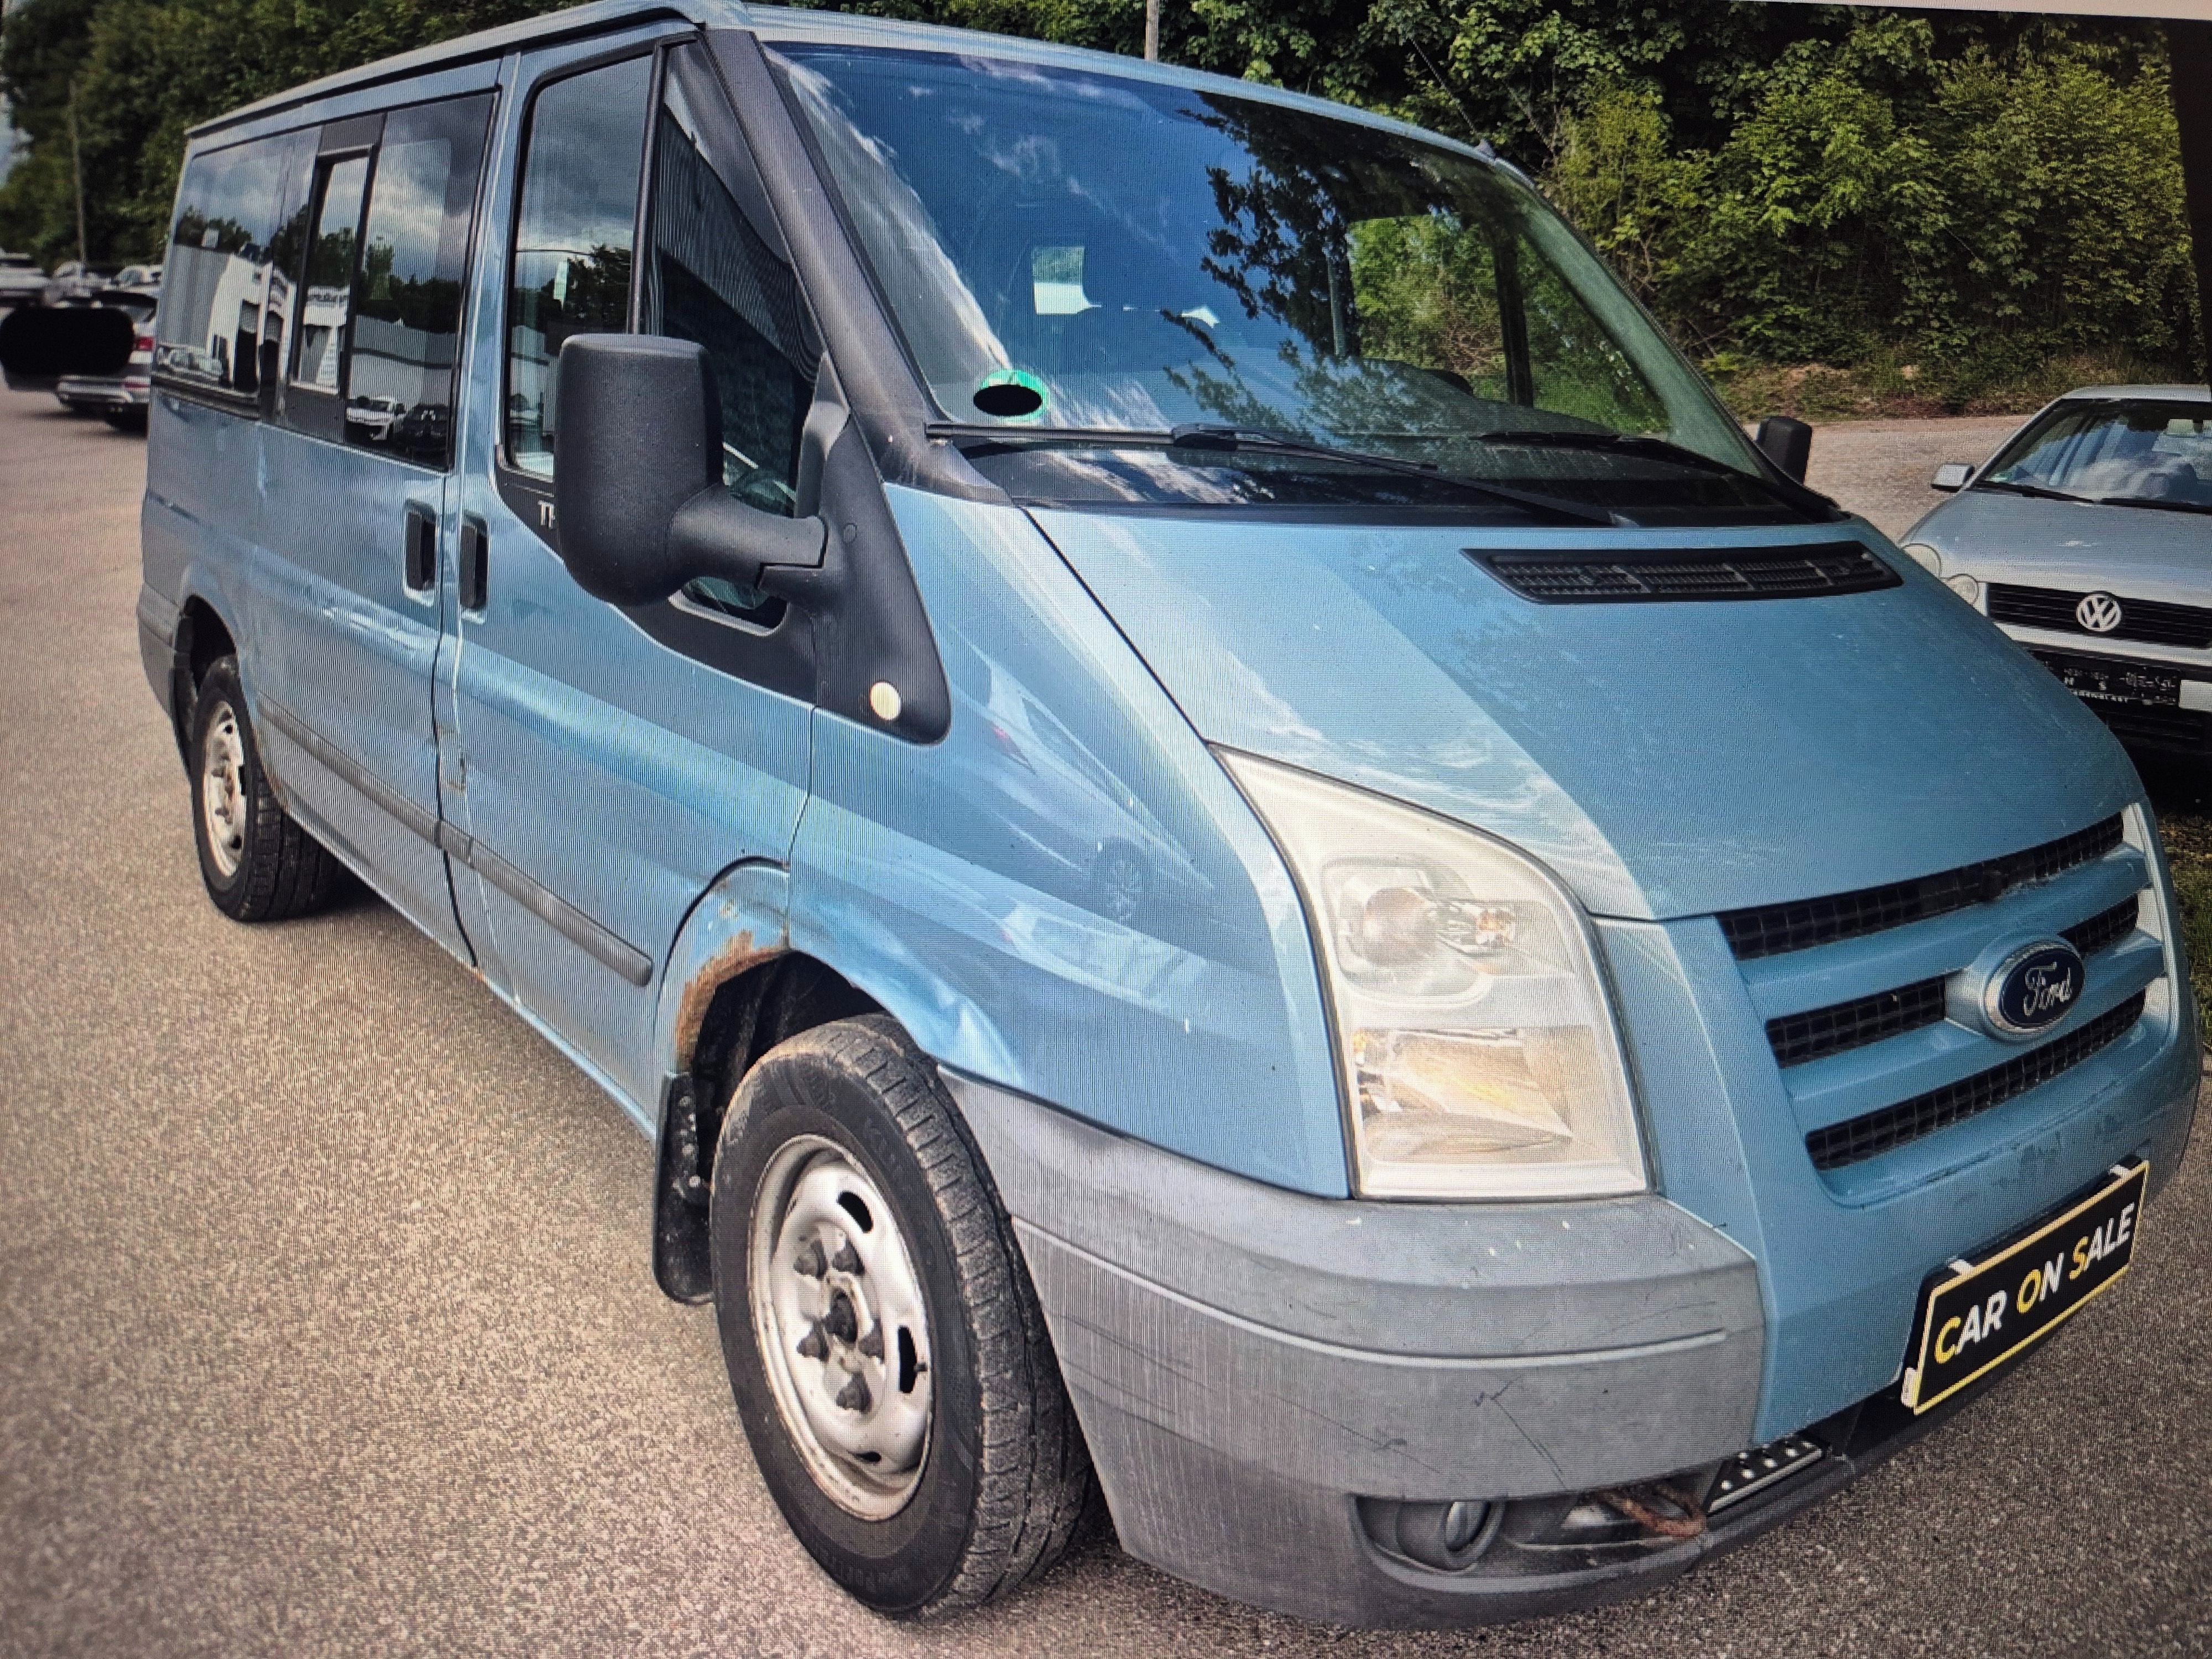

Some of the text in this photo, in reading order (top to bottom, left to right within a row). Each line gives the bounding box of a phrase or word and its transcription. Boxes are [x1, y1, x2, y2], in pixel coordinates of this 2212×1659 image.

[2023, 961, 2074, 1018] Ford
[1934, 1202, 2135, 1364] CAR ON SALE
